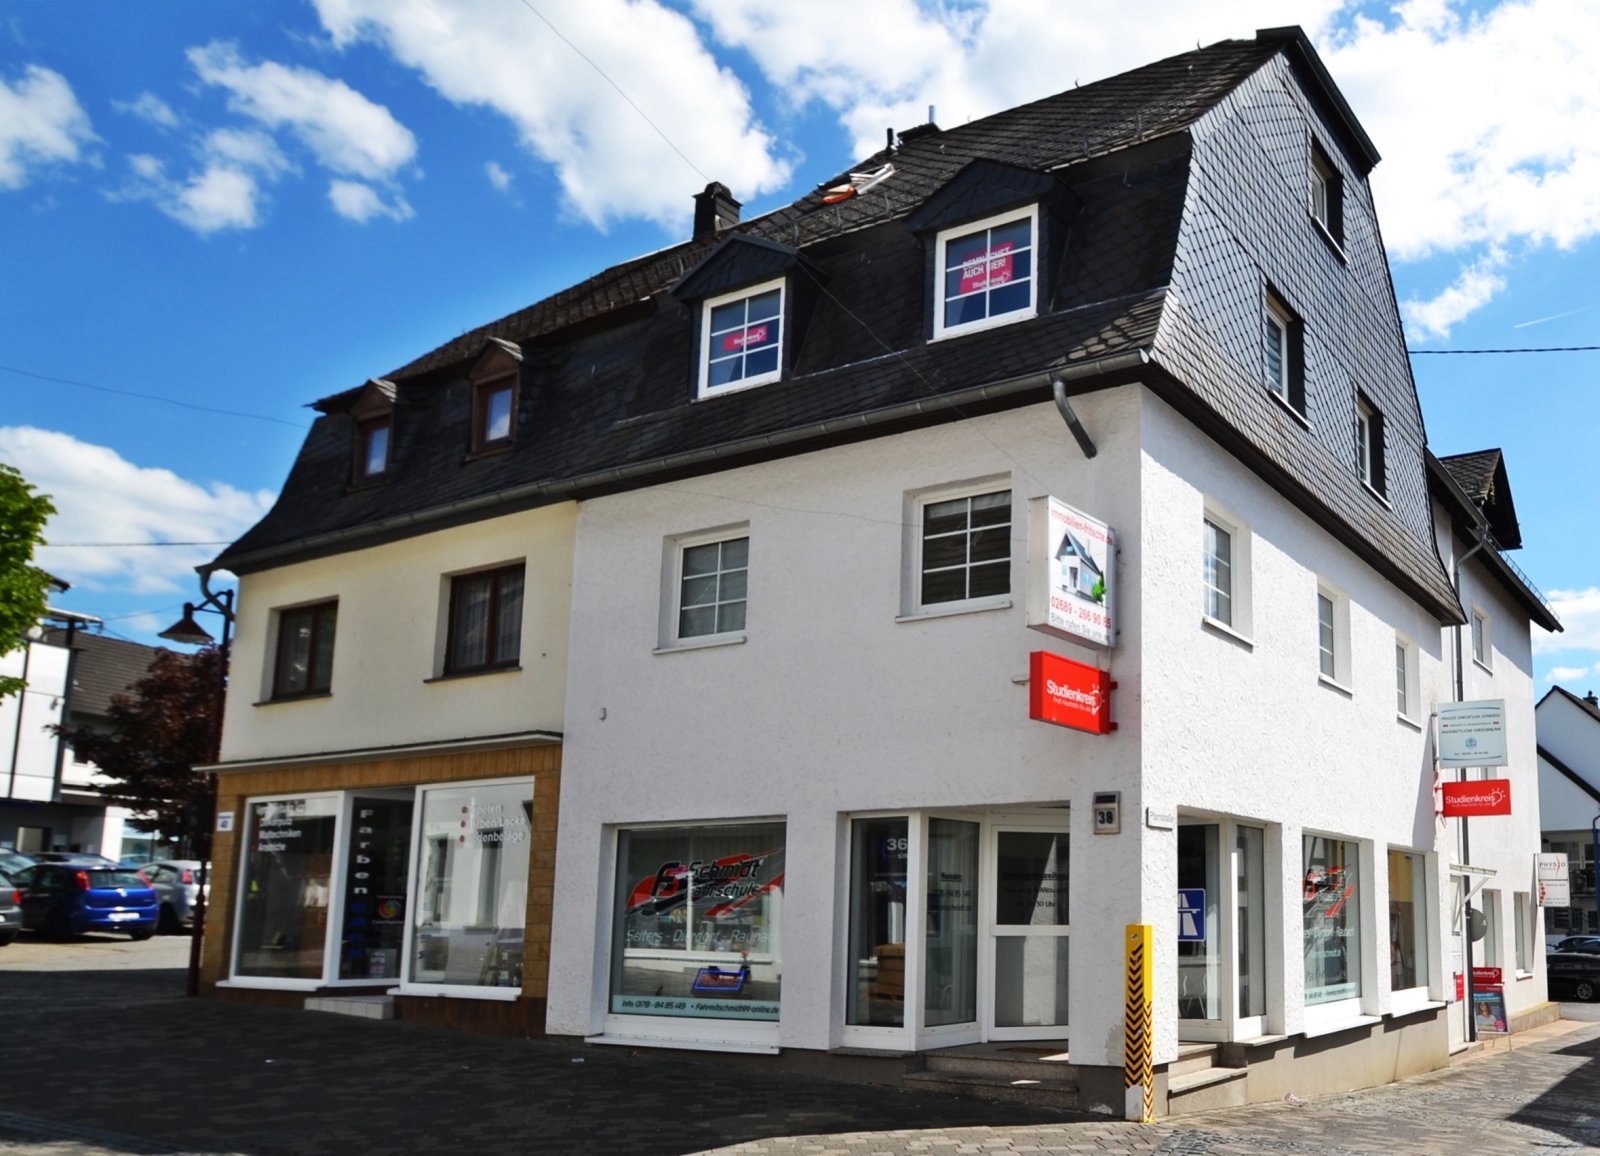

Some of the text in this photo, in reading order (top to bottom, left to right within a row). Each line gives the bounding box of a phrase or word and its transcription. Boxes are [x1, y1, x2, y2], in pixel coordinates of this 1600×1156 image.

[962, 265, 984, 279] AUCH
[1046, 679, 1096, 706] Studienkreis
[1445, 792, 1496, 805] Studienkreis
[1098, 811, 1113, 824] 38
[690, 858, 762, 880] Schmidt
